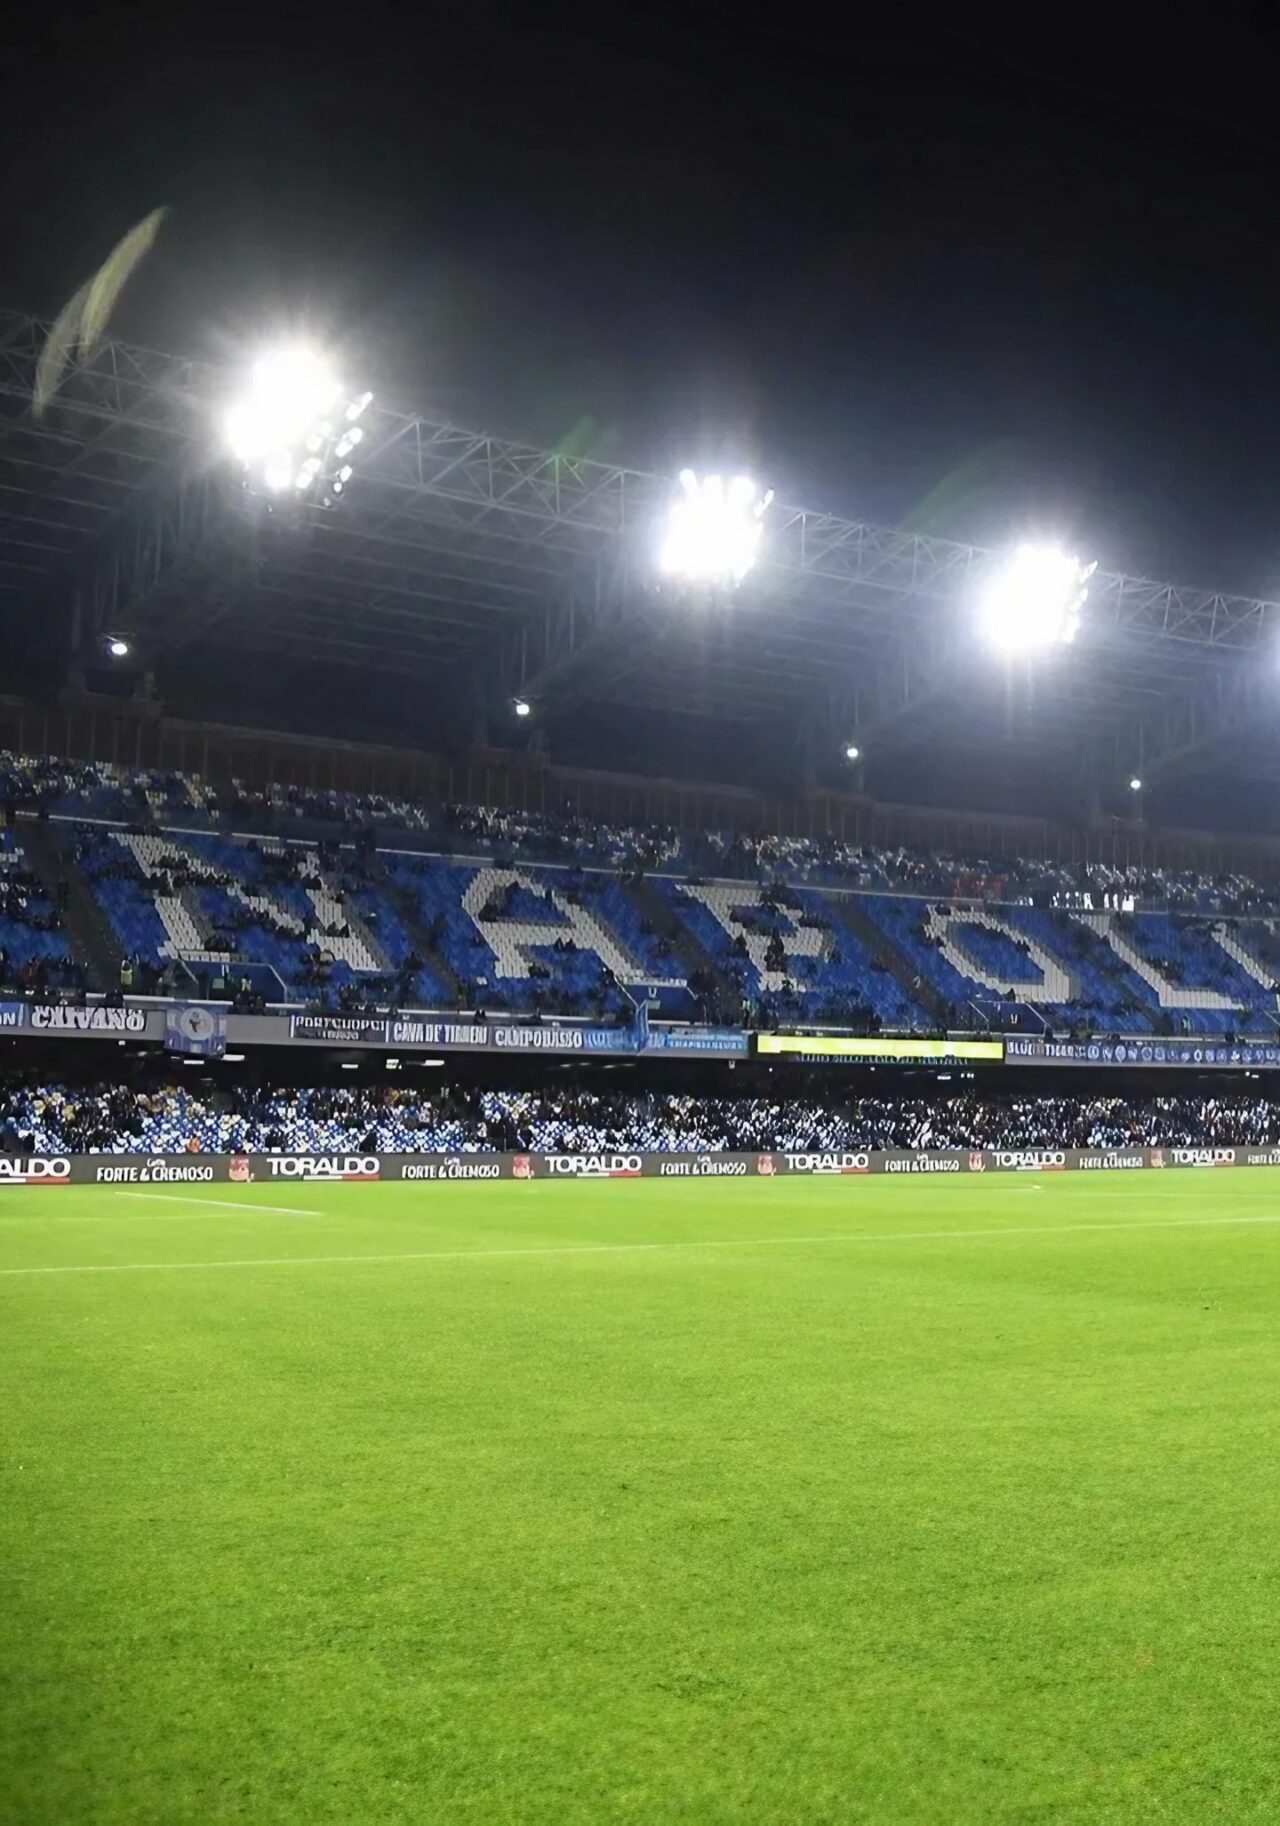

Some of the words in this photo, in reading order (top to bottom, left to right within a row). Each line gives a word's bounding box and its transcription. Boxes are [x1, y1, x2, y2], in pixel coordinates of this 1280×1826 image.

[544, 1155, 642, 1173] TORALDO
[785, 1153, 869, 1169] TORALDO
[992, 1151, 1066, 1166] TORALDO
[1171, 1149, 1236, 1164] TORALDO
[97, 1166, 138, 1181] FORTE
[151, 1166, 214, 1181] CREMOSO
[266, 1157, 380, 1175] TORALDO
[402, 1165, 436, 1178] FORTE
[448, 1164, 500, 1178] CREMOSO
